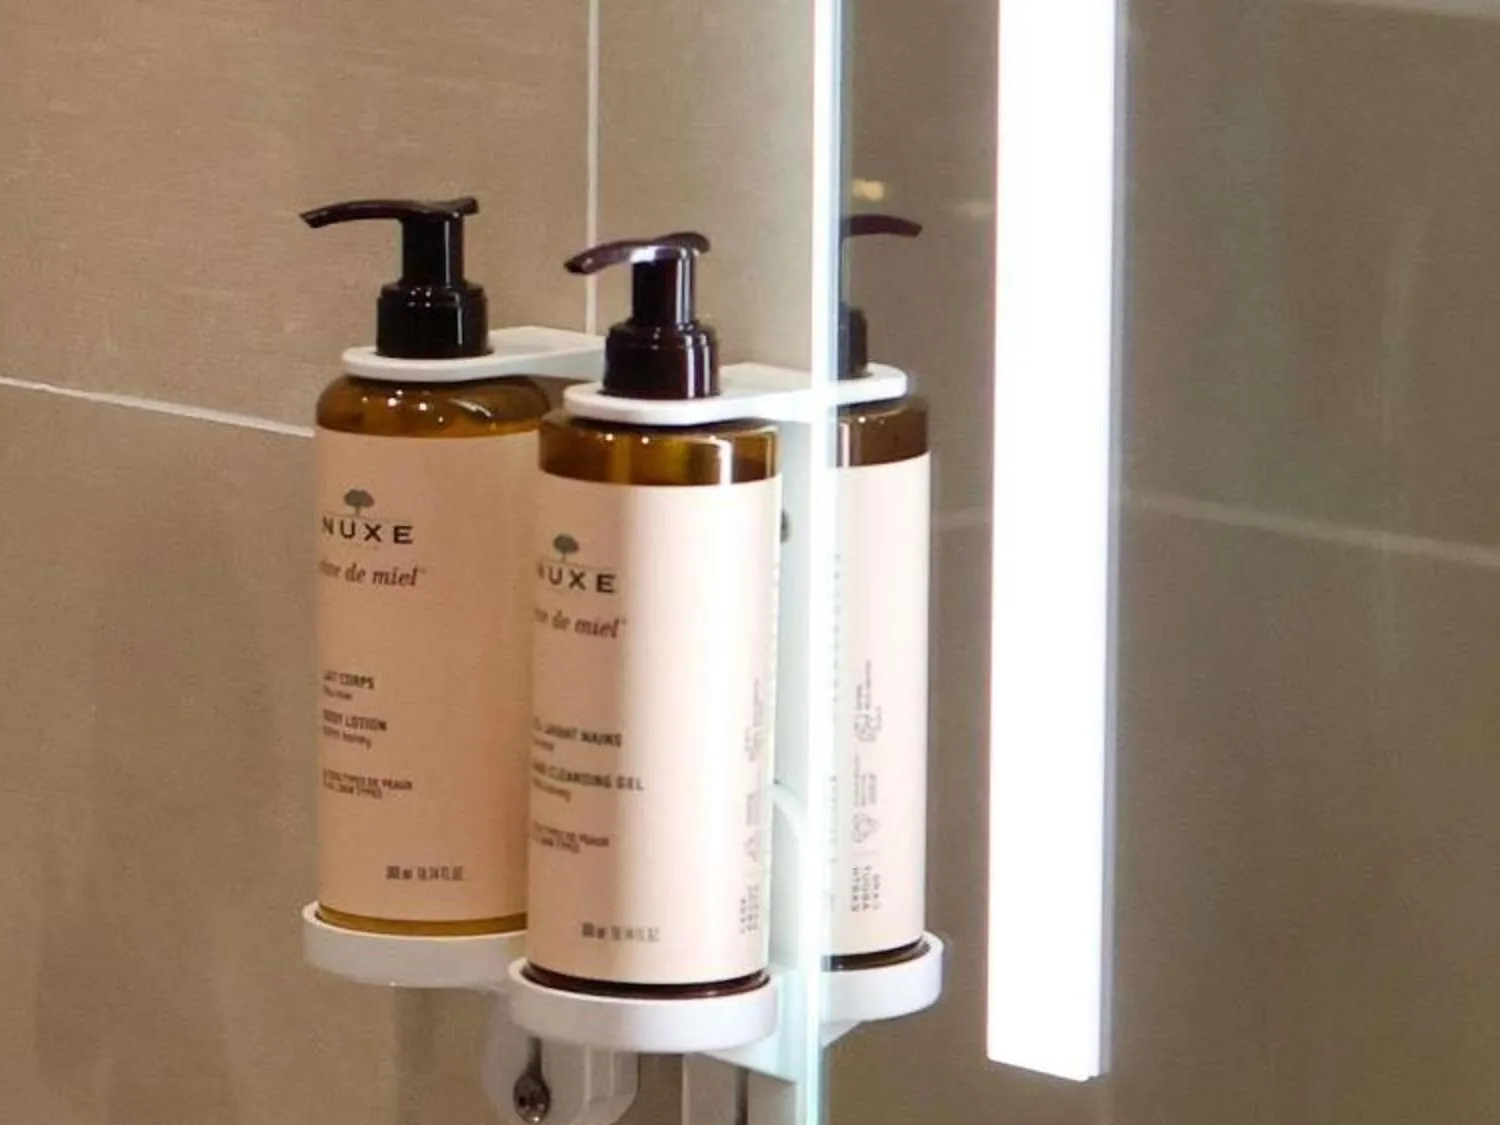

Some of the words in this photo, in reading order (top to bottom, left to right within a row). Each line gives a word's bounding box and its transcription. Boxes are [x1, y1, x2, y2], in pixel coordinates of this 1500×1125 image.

[322, 514, 414, 545] NUXE
[345, 562, 367, 583] de
[372, 566, 419, 587] miel
[344, 714, 388, 732] LOTION
[580, 731, 623, 748] MAINS
[616, 774, 644, 792] GEL
